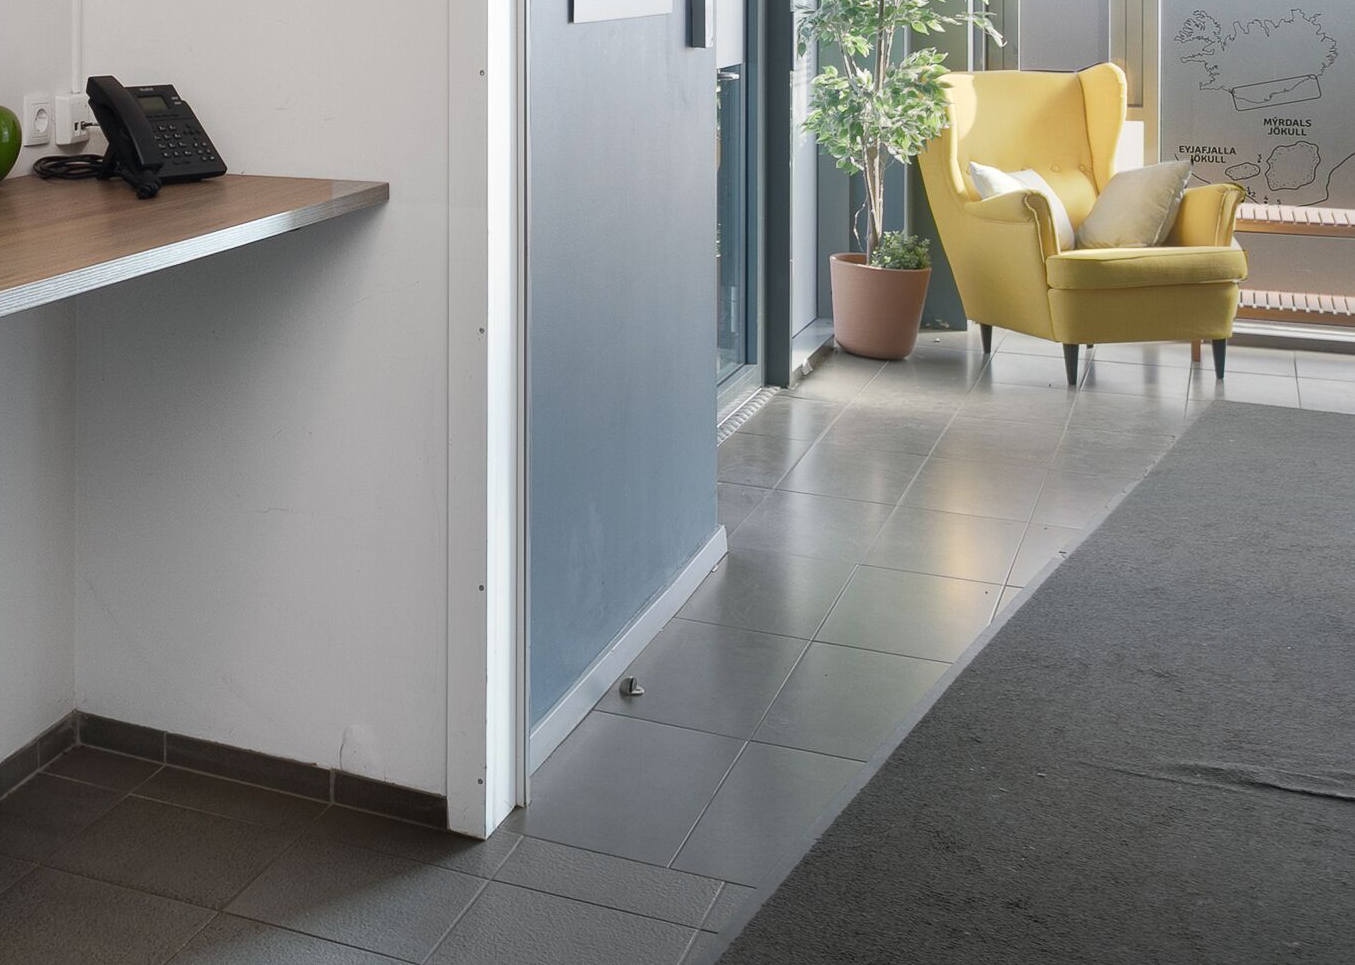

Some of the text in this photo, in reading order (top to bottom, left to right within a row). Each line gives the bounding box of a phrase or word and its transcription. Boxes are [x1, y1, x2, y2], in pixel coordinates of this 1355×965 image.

[1263, 116, 1313, 128] MÝRDALS
[1267, 126, 1308, 137] JÖKULL
[1178, 144, 1238, 156] EYJAFJALLA
[1190, 153, 1227, 165] JÖKULL
